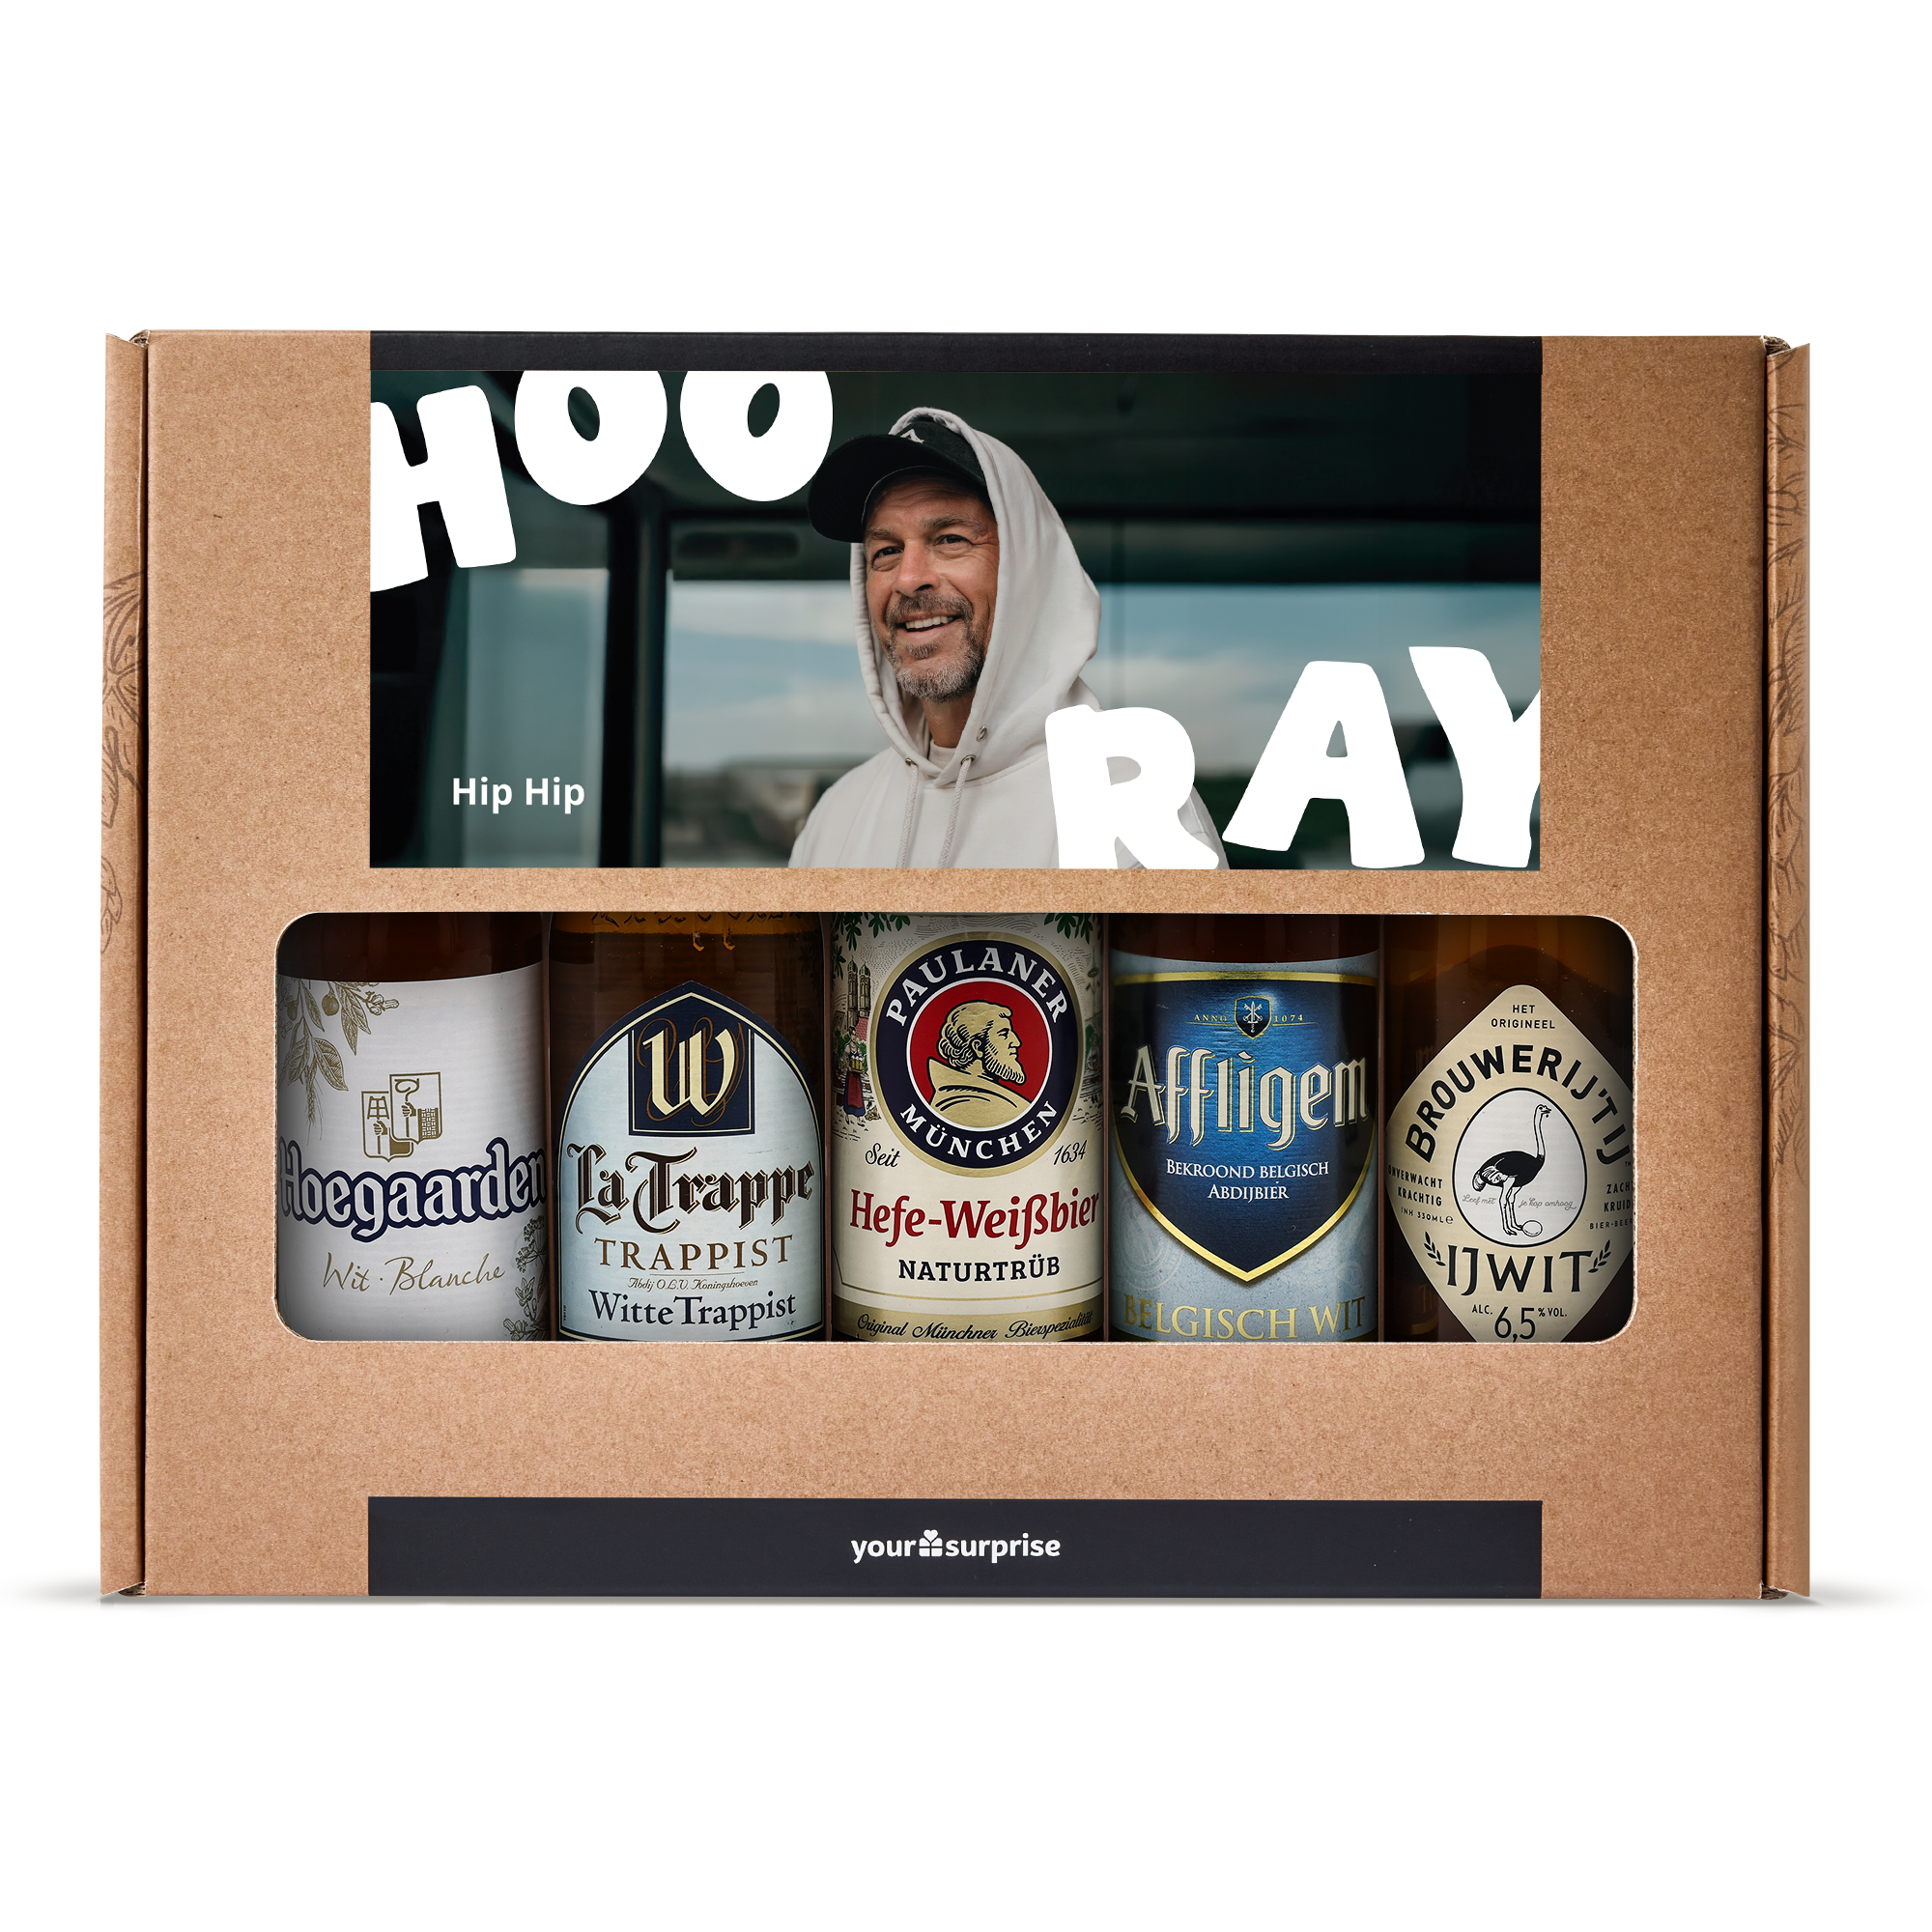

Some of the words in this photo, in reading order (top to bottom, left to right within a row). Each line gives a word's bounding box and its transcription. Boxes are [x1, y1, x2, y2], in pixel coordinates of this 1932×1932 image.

[370, 370, 834, 592] HOO
[1045, 646, 1541, 869] RAY
[452, 777, 513, 814] Hip
[526, 777, 585, 814] Hip
[886, 947, 1068, 1026] PAULANER
[1194, 1014, 1228, 1023] ANNO
[1273, 1013, 1304, 1023] 1074
[1491, 1017, 1556, 1030] ORIGINEEL
[1512, 1004, 1536, 1014] HET
[1121, 1043, 1369, 1151] Affligem
[899, 1100, 1059, 1160] MÜNCHEN
[865, 1143, 900, 1168] Seit
[1053, 1140, 1089, 1166] 1634
[1166, 1158, 1255, 1179] BEKROOND
[1260, 1161, 1329, 1179] BELGISCH
[278, 1136, 548, 1243] Hoegaarden
[567, 1143, 630, 1235] La
[625, 1147, 815, 1236] Trappe
[1208, 1183, 1290, 1203] ABDIJBIER
[1387, 1164, 1443, 1189] ONVERWACHT
[1398, 1186, 1442, 1207] KRACHTIG
[1401, 1207, 1414, 1216] INH
[1544, 1199, 1577, 1211] omhoog
[1604, 1199, 1634, 1212] KRUID
[850, 1187, 1099, 1250] Hefe-Weißbier
[594, 1234, 793, 1271] TRAPPIST
[898, 1253, 1061, 1282] NATURTRÜB
[323, 1252, 371, 1293] Wit
[384, 1253, 506, 1296] Blanche
[627, 1277, 655, 1293] Abdij
[690, 1277, 759, 1292] Koningshoeven
[1446, 1244, 1594, 1296] IJWIT
[588, 1289, 673, 1324] Witte
[673, 1290, 797, 1332] Trappist
[857, 1313, 910, 1339] Original
[912, 1321, 999, 1340] Münchner
[1004, 1310, 1094, 1339] Bierspezialität
[1123, 1293, 1298, 1340] BELGISCH
[1308, 1296, 1366, 1336] WIT
[1471, 1304, 1493, 1315] ALC.
[1494, 1306, 1536, 1343] 6,5
[1548, 1307, 1568, 1318] VOL.
[850, 1539, 917, 1565] your
[945, 1532, 1061, 1564] surprise
